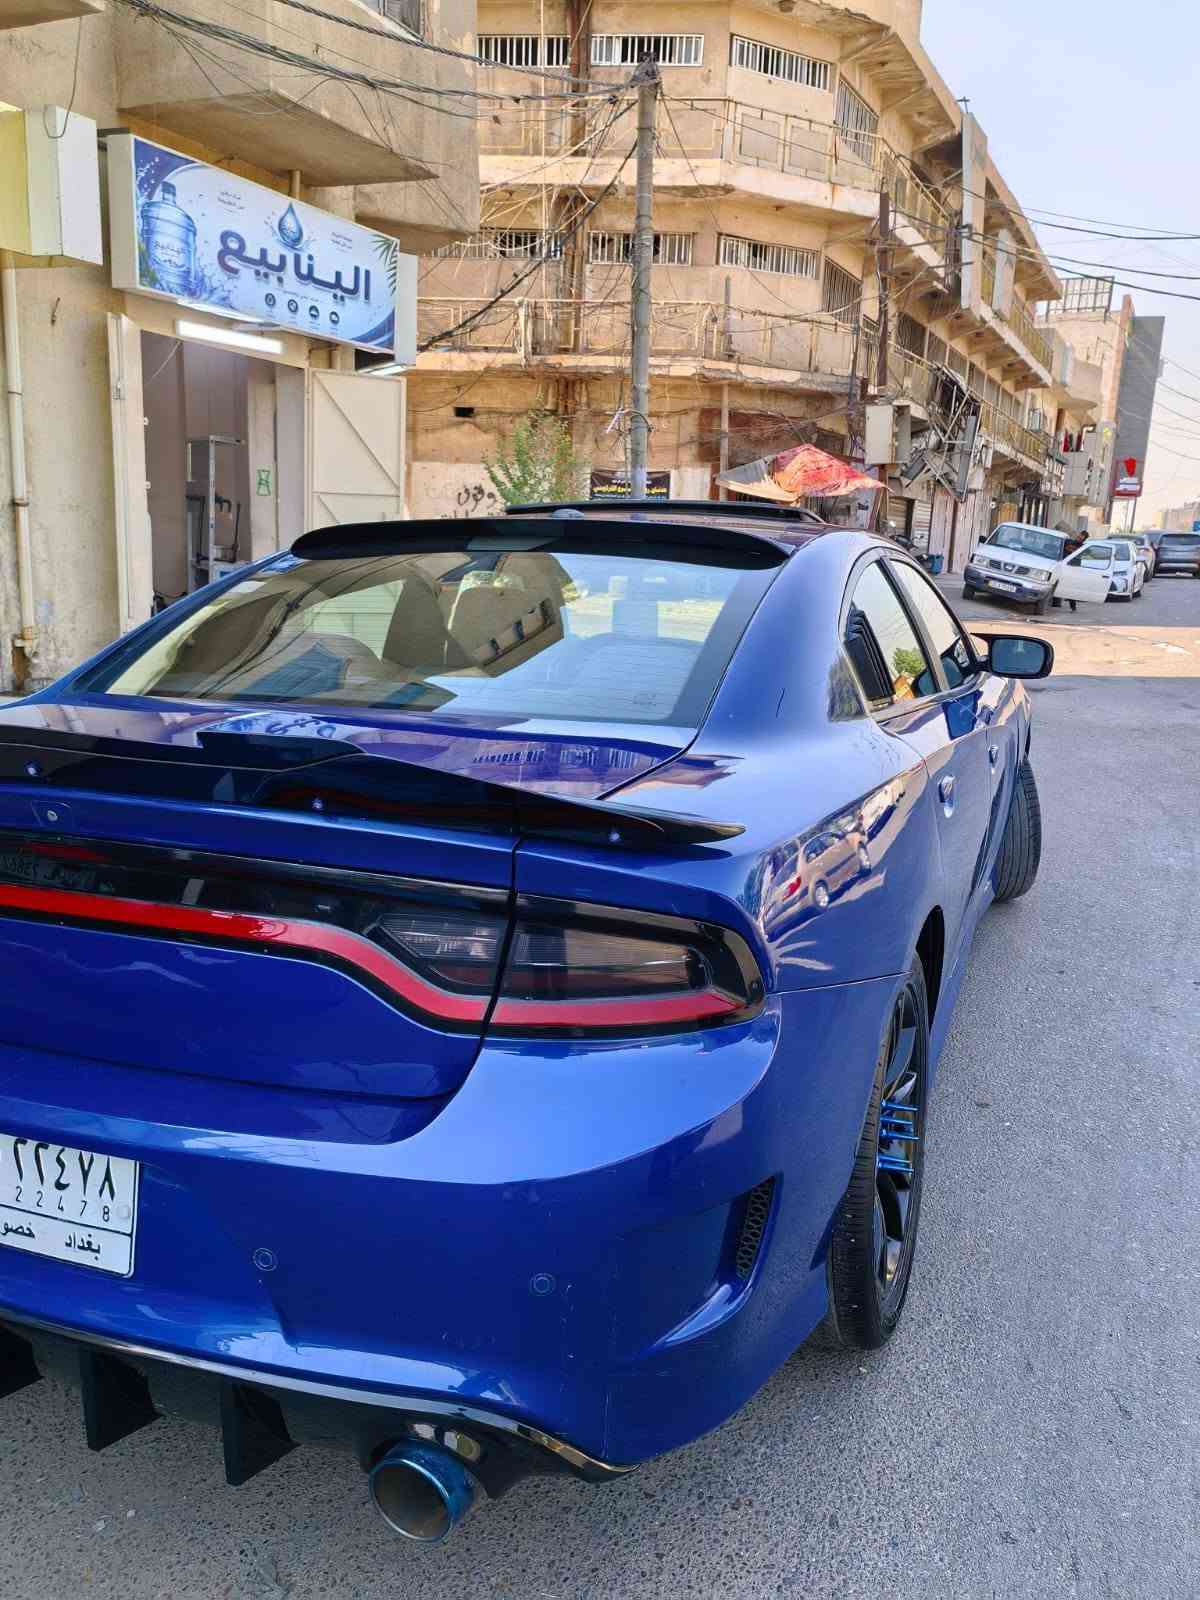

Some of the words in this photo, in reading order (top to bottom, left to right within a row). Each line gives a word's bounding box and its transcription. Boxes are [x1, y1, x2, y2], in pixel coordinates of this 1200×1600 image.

[217, 230, 371, 301] الينابيع
[13, 1138, 116, 1202] ٢٢٤٧٨
[15, 1185, 110, 1222] 22478
[65, 1230, 101, 1261] بغداد
